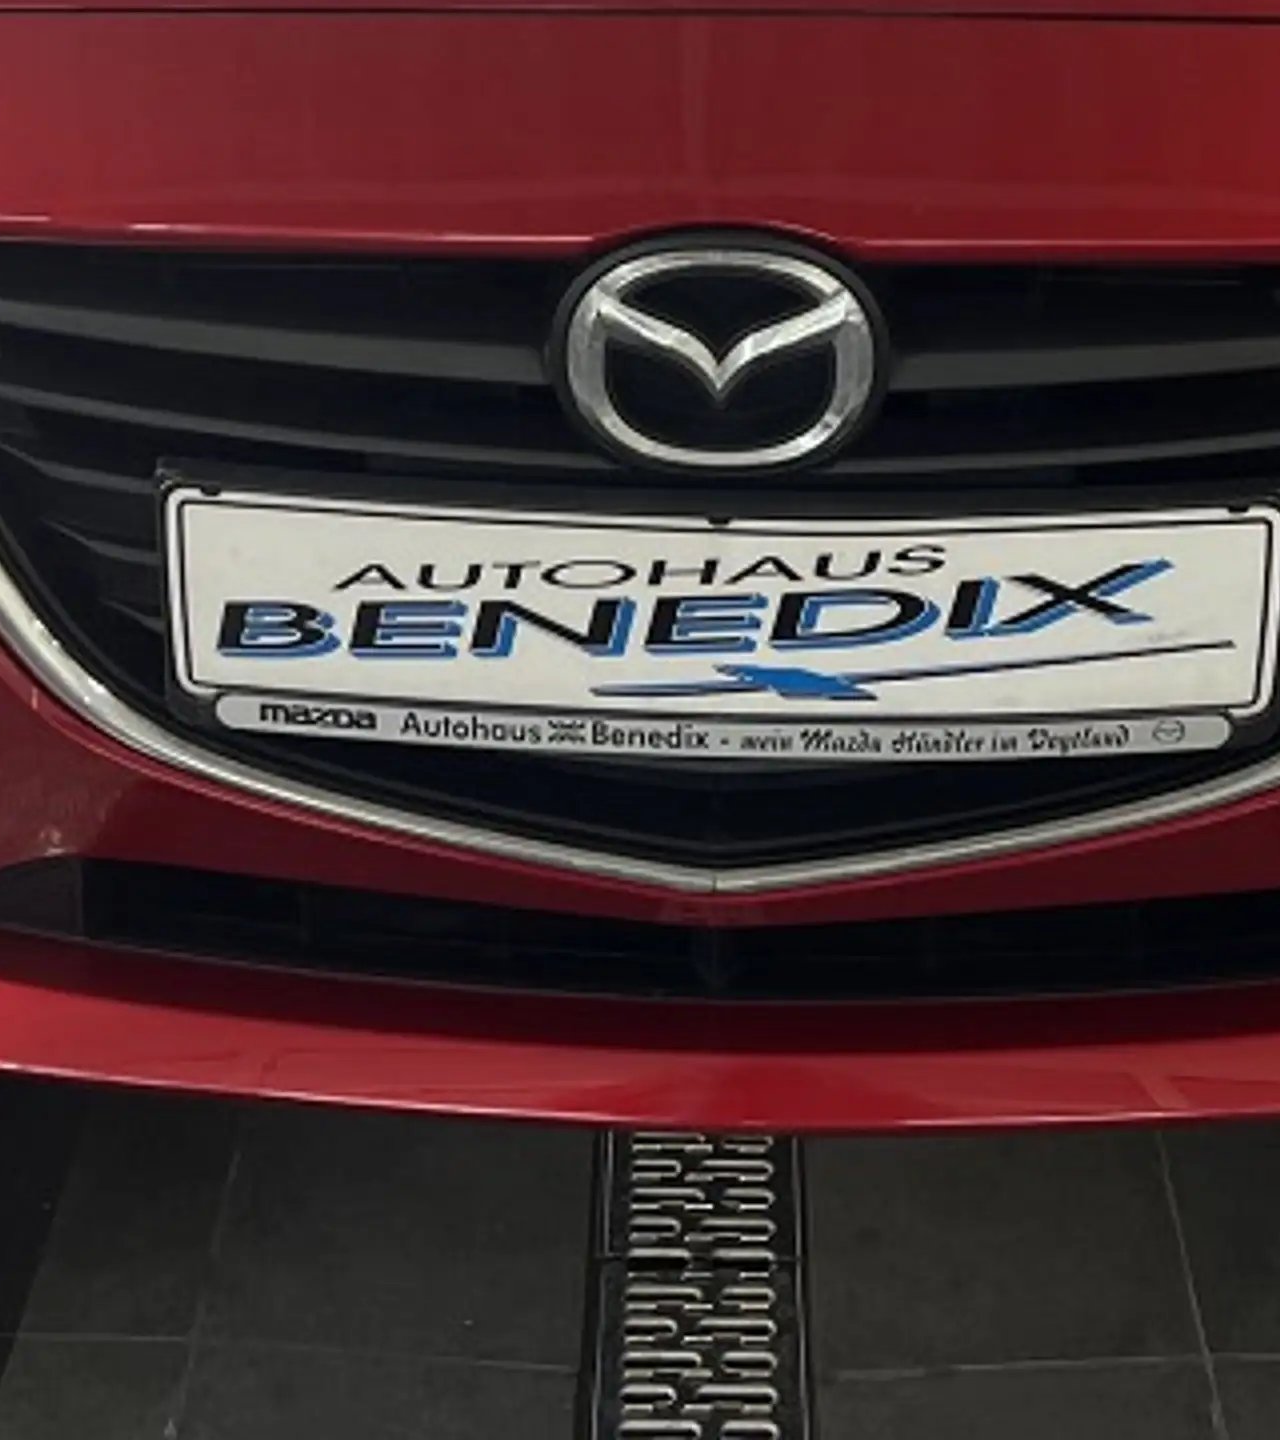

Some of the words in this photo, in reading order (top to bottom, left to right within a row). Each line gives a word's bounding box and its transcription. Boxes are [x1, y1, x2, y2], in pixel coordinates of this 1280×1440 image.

[332, 544, 947, 593] AUTOHAUS
[216, 558, 1175, 659] BENEDIX
[259, 703, 377, 730] mazda
[399, 711, 541, 744] Autohaus
[591, 722, 710, 749] Benedix
[799, 728, 882, 754] Mazda
